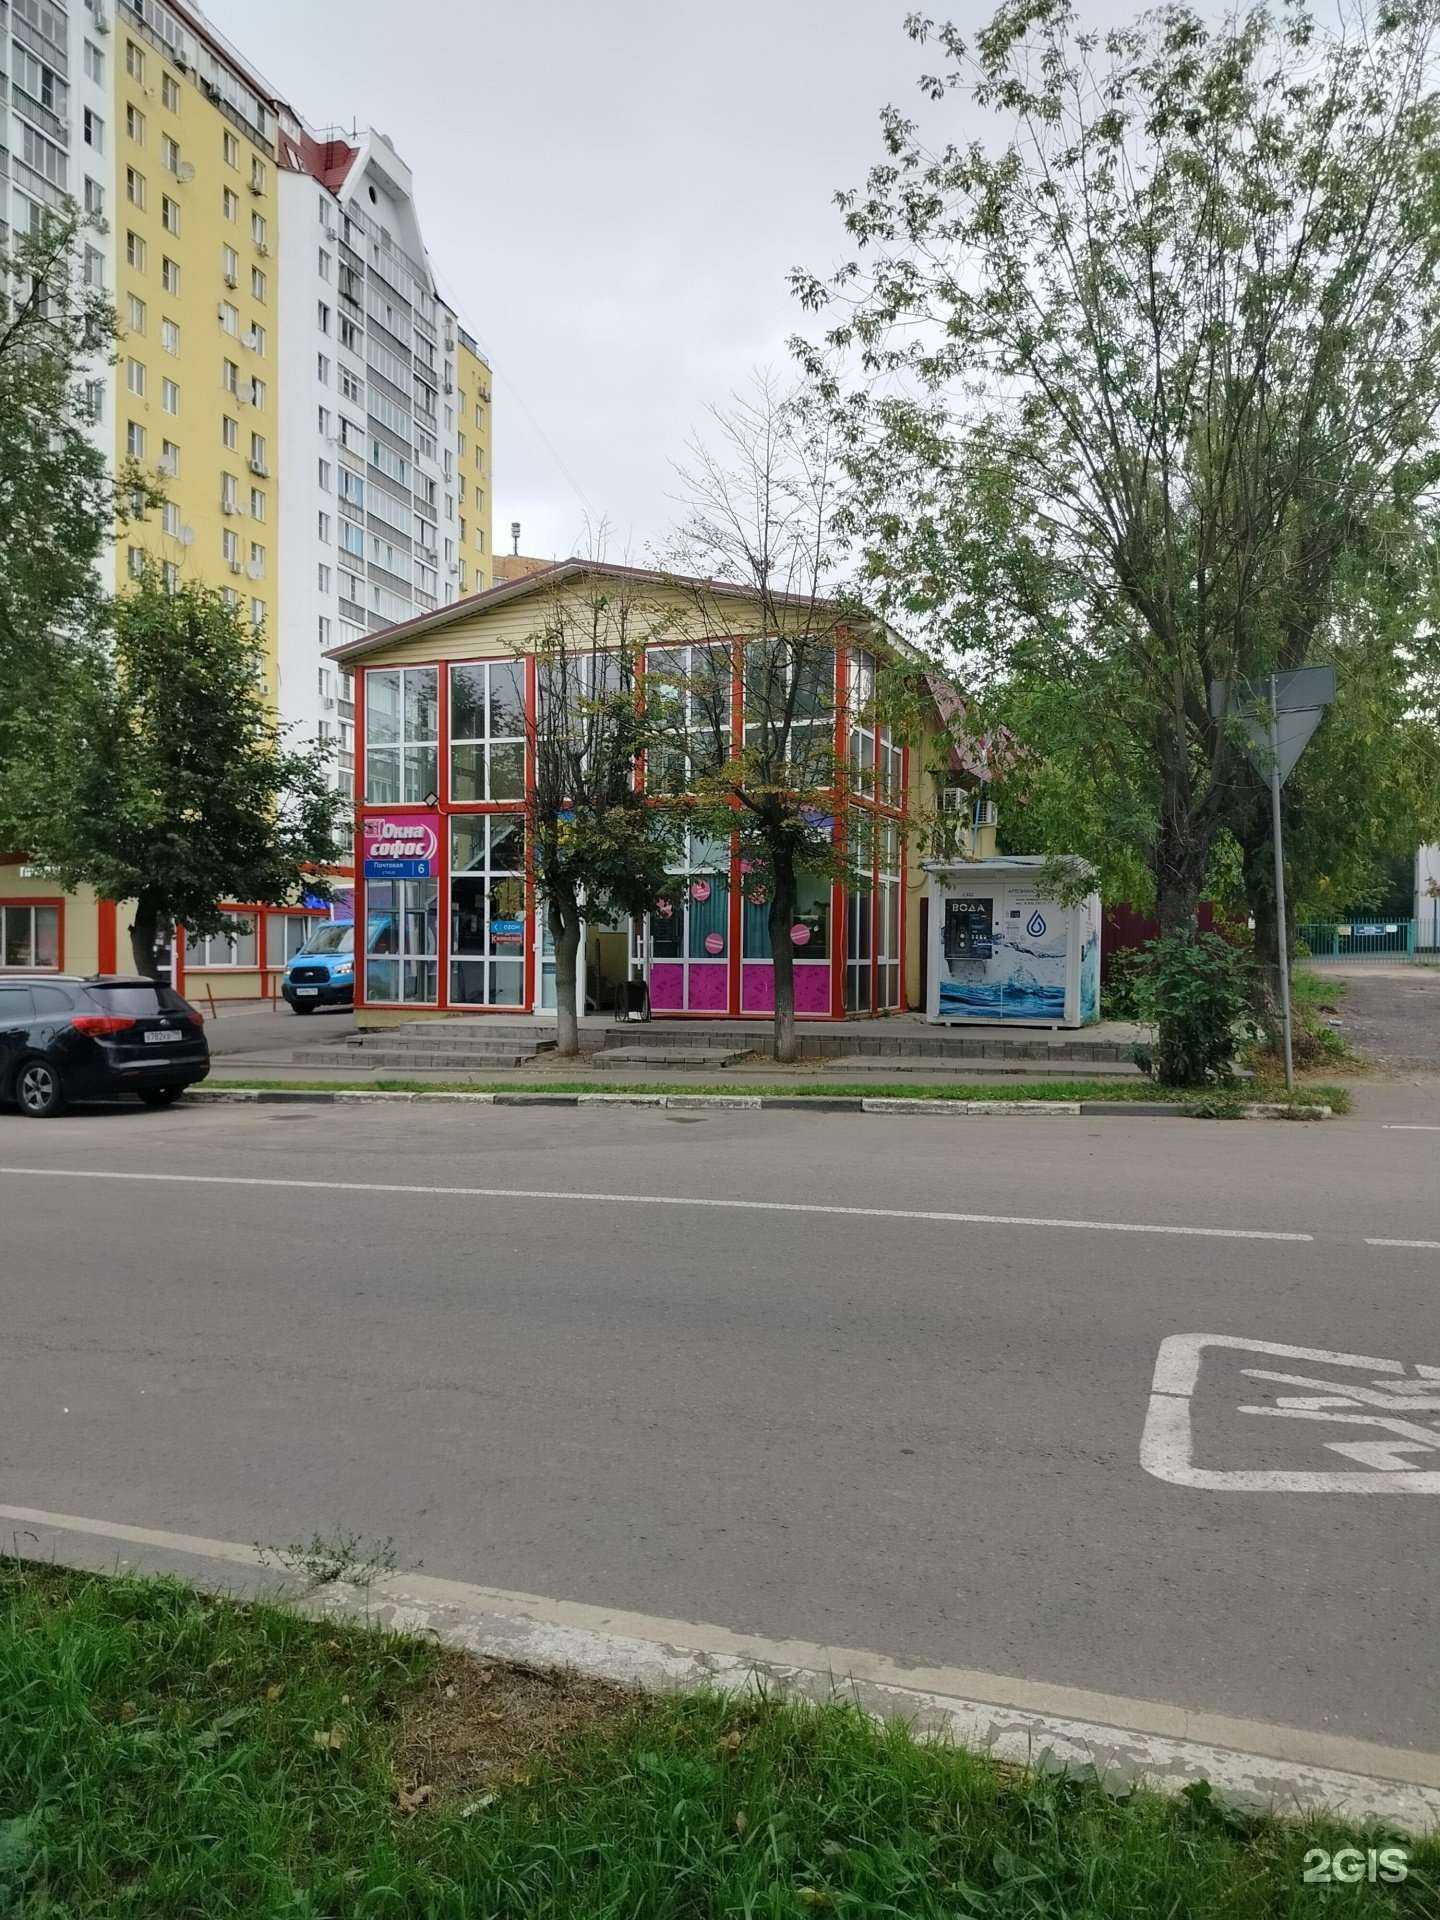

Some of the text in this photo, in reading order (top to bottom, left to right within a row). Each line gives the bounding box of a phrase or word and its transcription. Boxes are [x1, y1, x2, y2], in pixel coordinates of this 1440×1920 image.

[383, 823, 425, 839] Окна
[417, 863, 425, 874] 6
[952, 903, 985, 912] ВОДА
